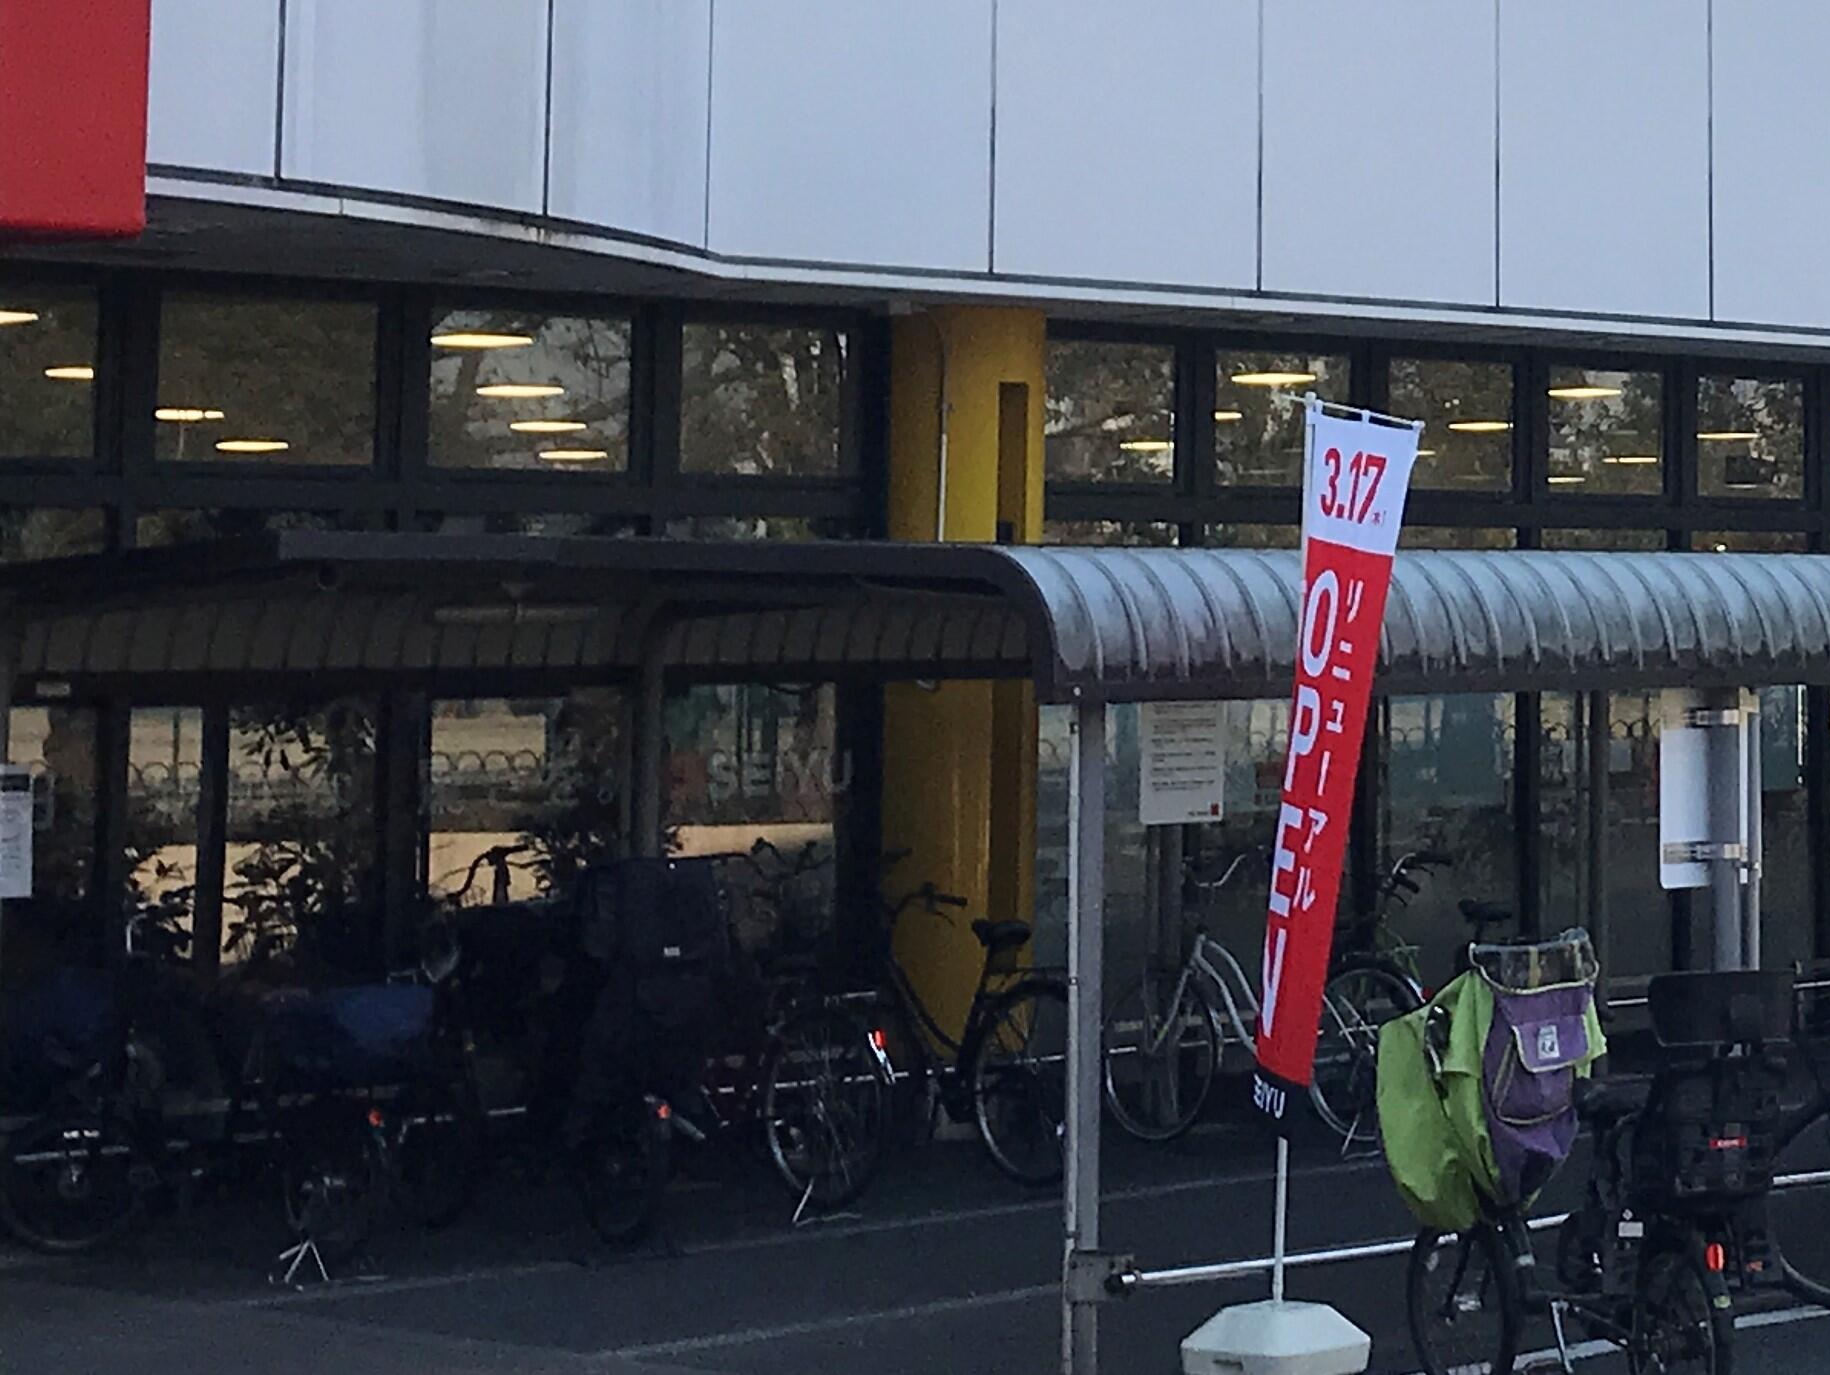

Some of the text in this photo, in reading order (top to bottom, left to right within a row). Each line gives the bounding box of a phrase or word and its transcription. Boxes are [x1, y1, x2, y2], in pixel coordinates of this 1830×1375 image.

[1320, 447, 1388, 524] 3.17
[1293, 578, 1364, 912] リニューアル
